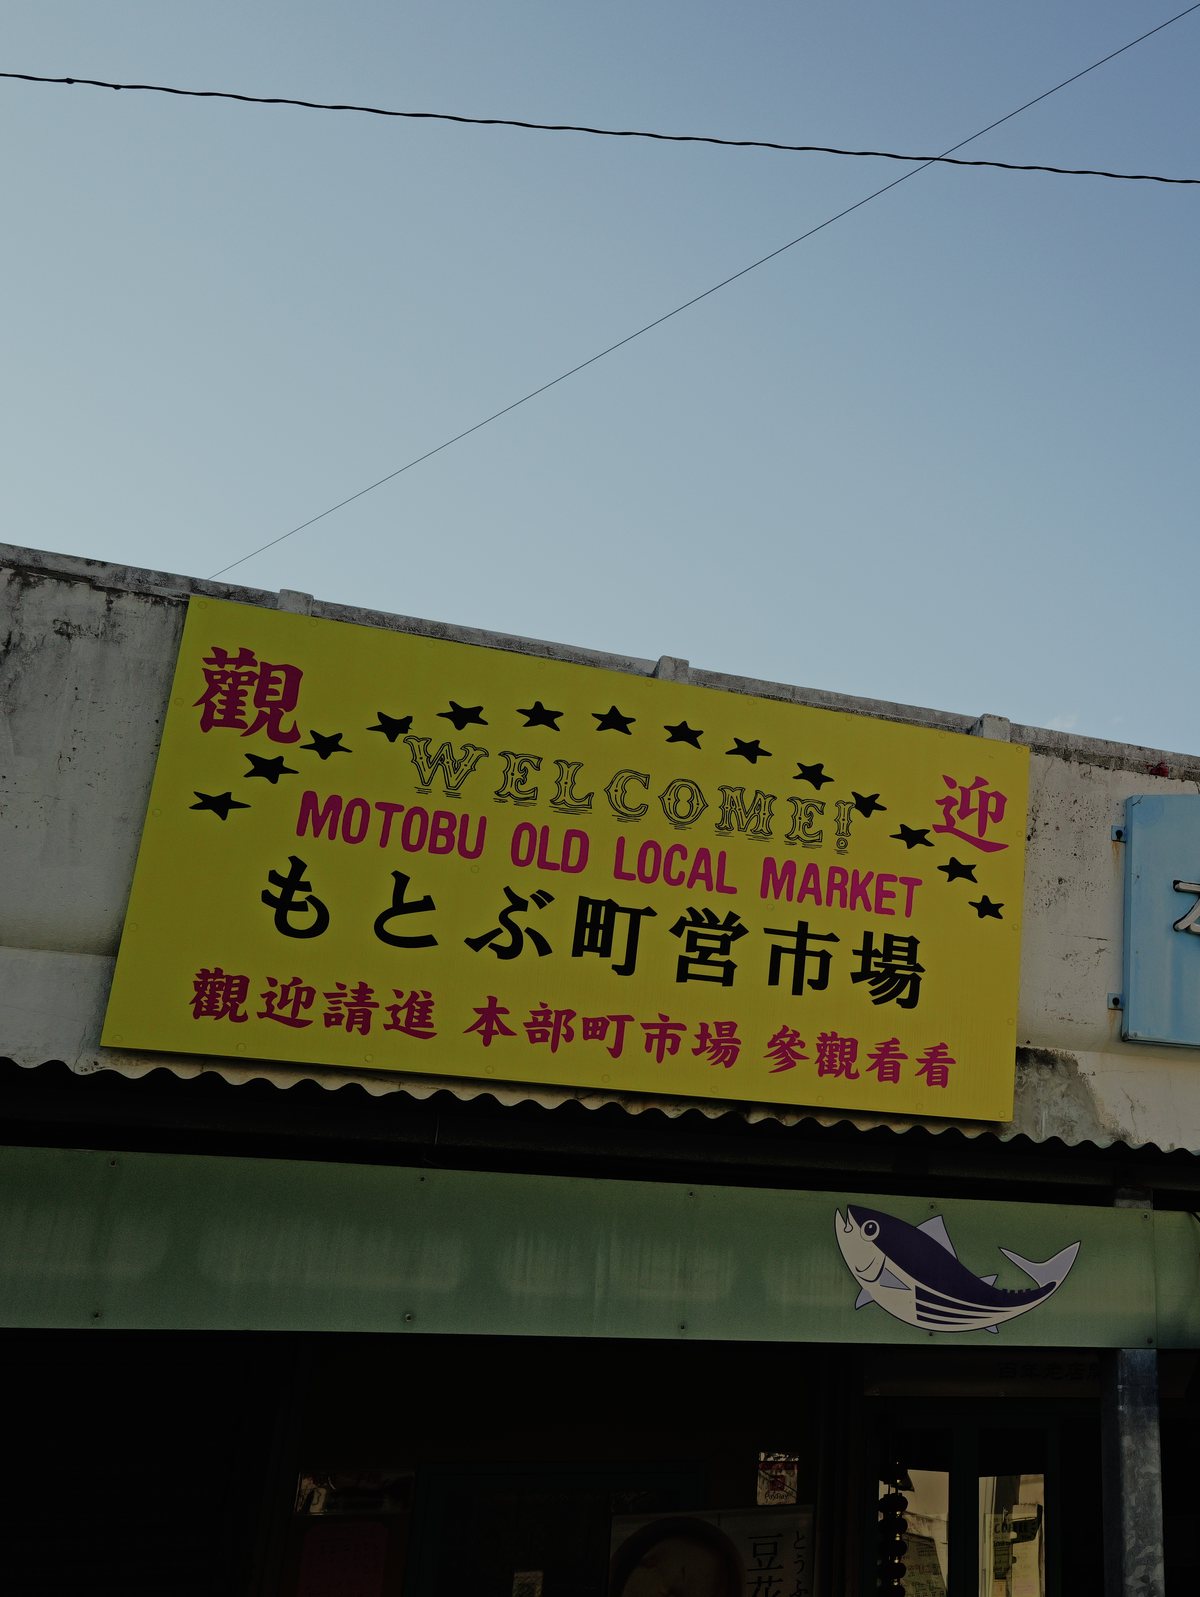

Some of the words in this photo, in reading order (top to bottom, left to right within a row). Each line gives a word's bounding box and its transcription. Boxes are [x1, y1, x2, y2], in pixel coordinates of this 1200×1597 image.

[192, 646, 304, 744] 觀
[296, 790, 487, 860] MOTOBU
[510, 822, 590, 874] OLD
[613, 836, 738, 895] LOCAL
[760, 856, 923, 918] MARKET
[403, 734, 857, 854] WELCOME!
[931, 774, 1009, 852] 迎
[260, 855, 927, 1010] もとぶ町営市場
[190, 966, 438, 1041] 觀迎請進
[463, 995, 742, 1069] 本部町市場
[763, 1024, 957, 1089] 參觀看看
